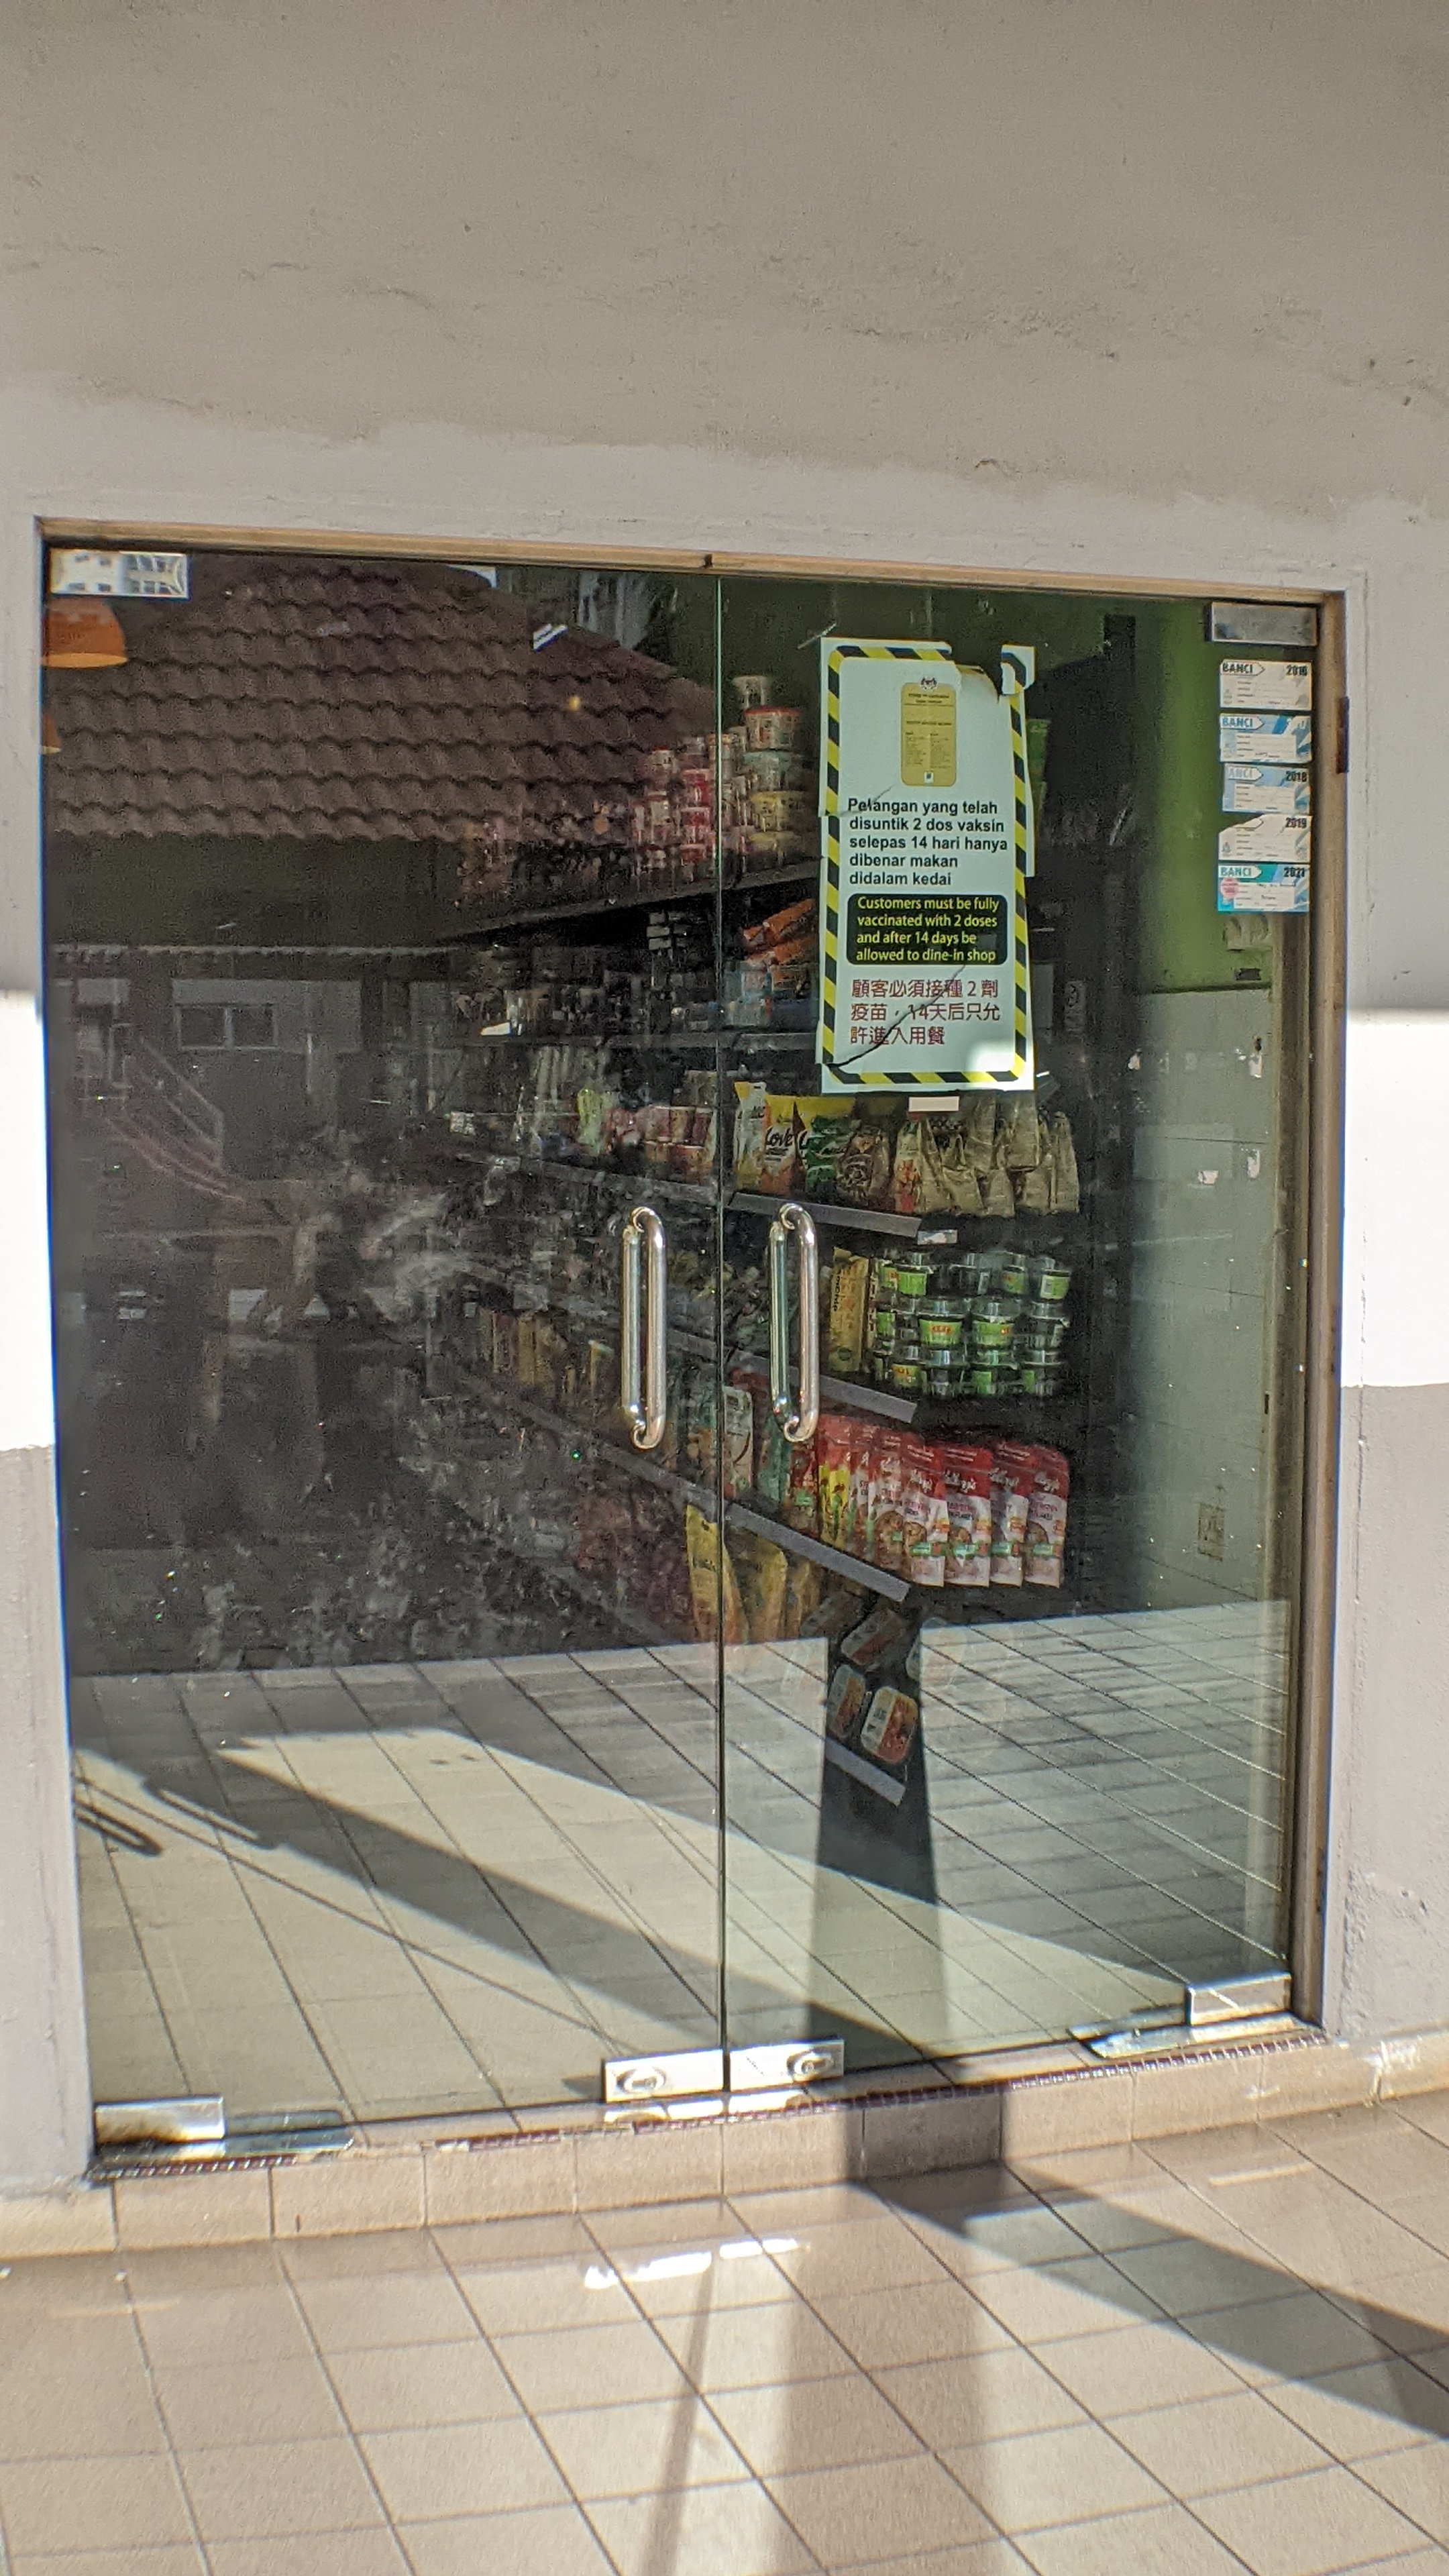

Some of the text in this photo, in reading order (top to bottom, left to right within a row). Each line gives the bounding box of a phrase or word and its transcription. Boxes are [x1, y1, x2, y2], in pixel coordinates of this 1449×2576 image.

[1222, 662, 1253, 674] BANCI
[1222, 716, 1253, 729] BANCI
[1228, 766, 1253, 779] ANCI
[847, 798, 998, 816] Pelangan yang telah
[849, 816, 1005, 833] disuntik 2 dos vaksin
[849, 835, 1008, 853] selepas 14 hari hanya
[849, 853, 959, 868] dibenar makan
[849, 871, 952, 886] didalam kedai
[1220, 867, 1252, 877] BANCI
[857, 896, 1000, 913] Customers must be fully
[857, 914, 998, 928] vaccinated with 2 doses
[856, 931, 977, 947] and after 14 days be
[856, 948, 997, 964] allowed to dine-in shop
[850, 1026, 946, 1046] 許進入用餐
